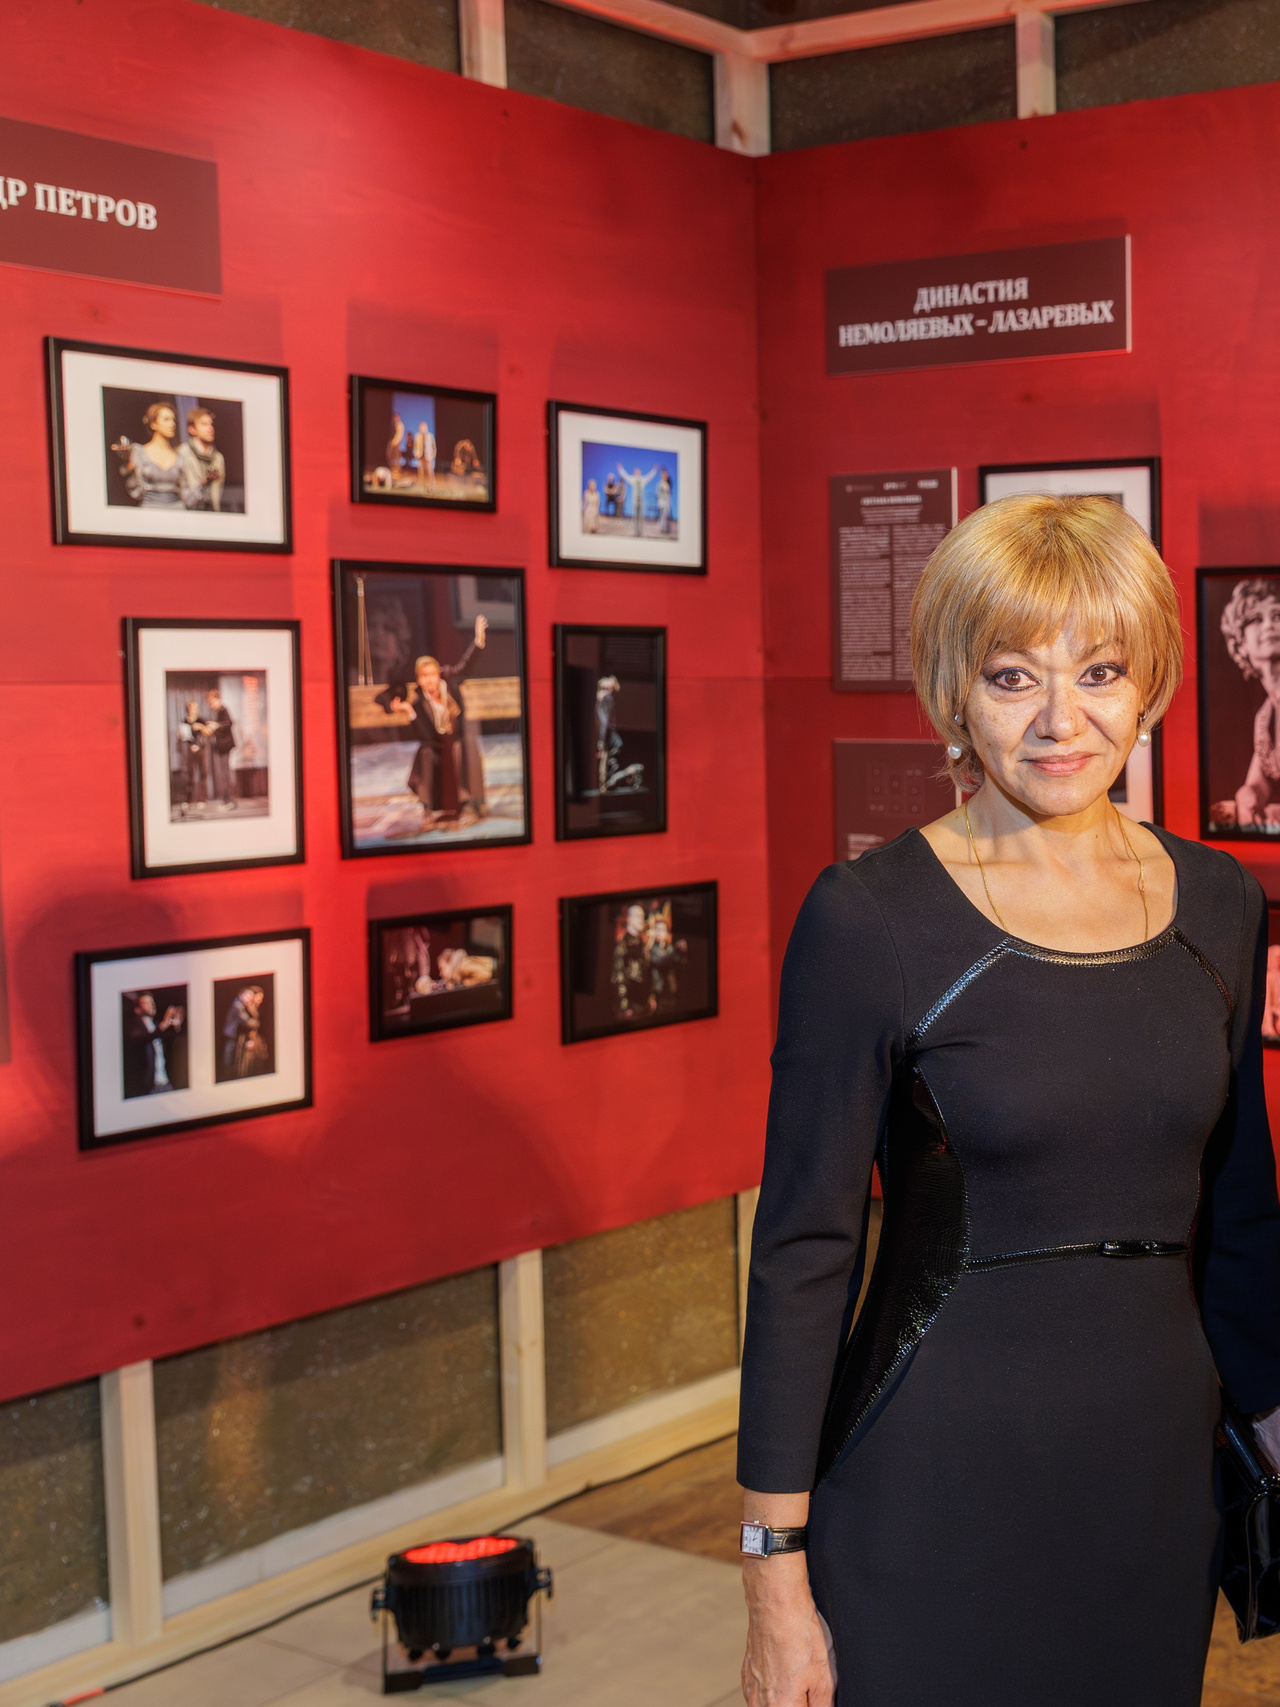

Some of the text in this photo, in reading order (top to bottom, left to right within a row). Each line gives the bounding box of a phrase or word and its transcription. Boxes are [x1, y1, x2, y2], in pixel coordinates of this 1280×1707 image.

[34, 182, 158, 230] ПЕТРОВ
[914, 277, 1029, 314] ДИНАСТИЯ
[839, 313, 974, 347] НЕМОЛЯЕВЫХ
[987, 300, 1115, 334] ЛАЗАРЕВЫХ
